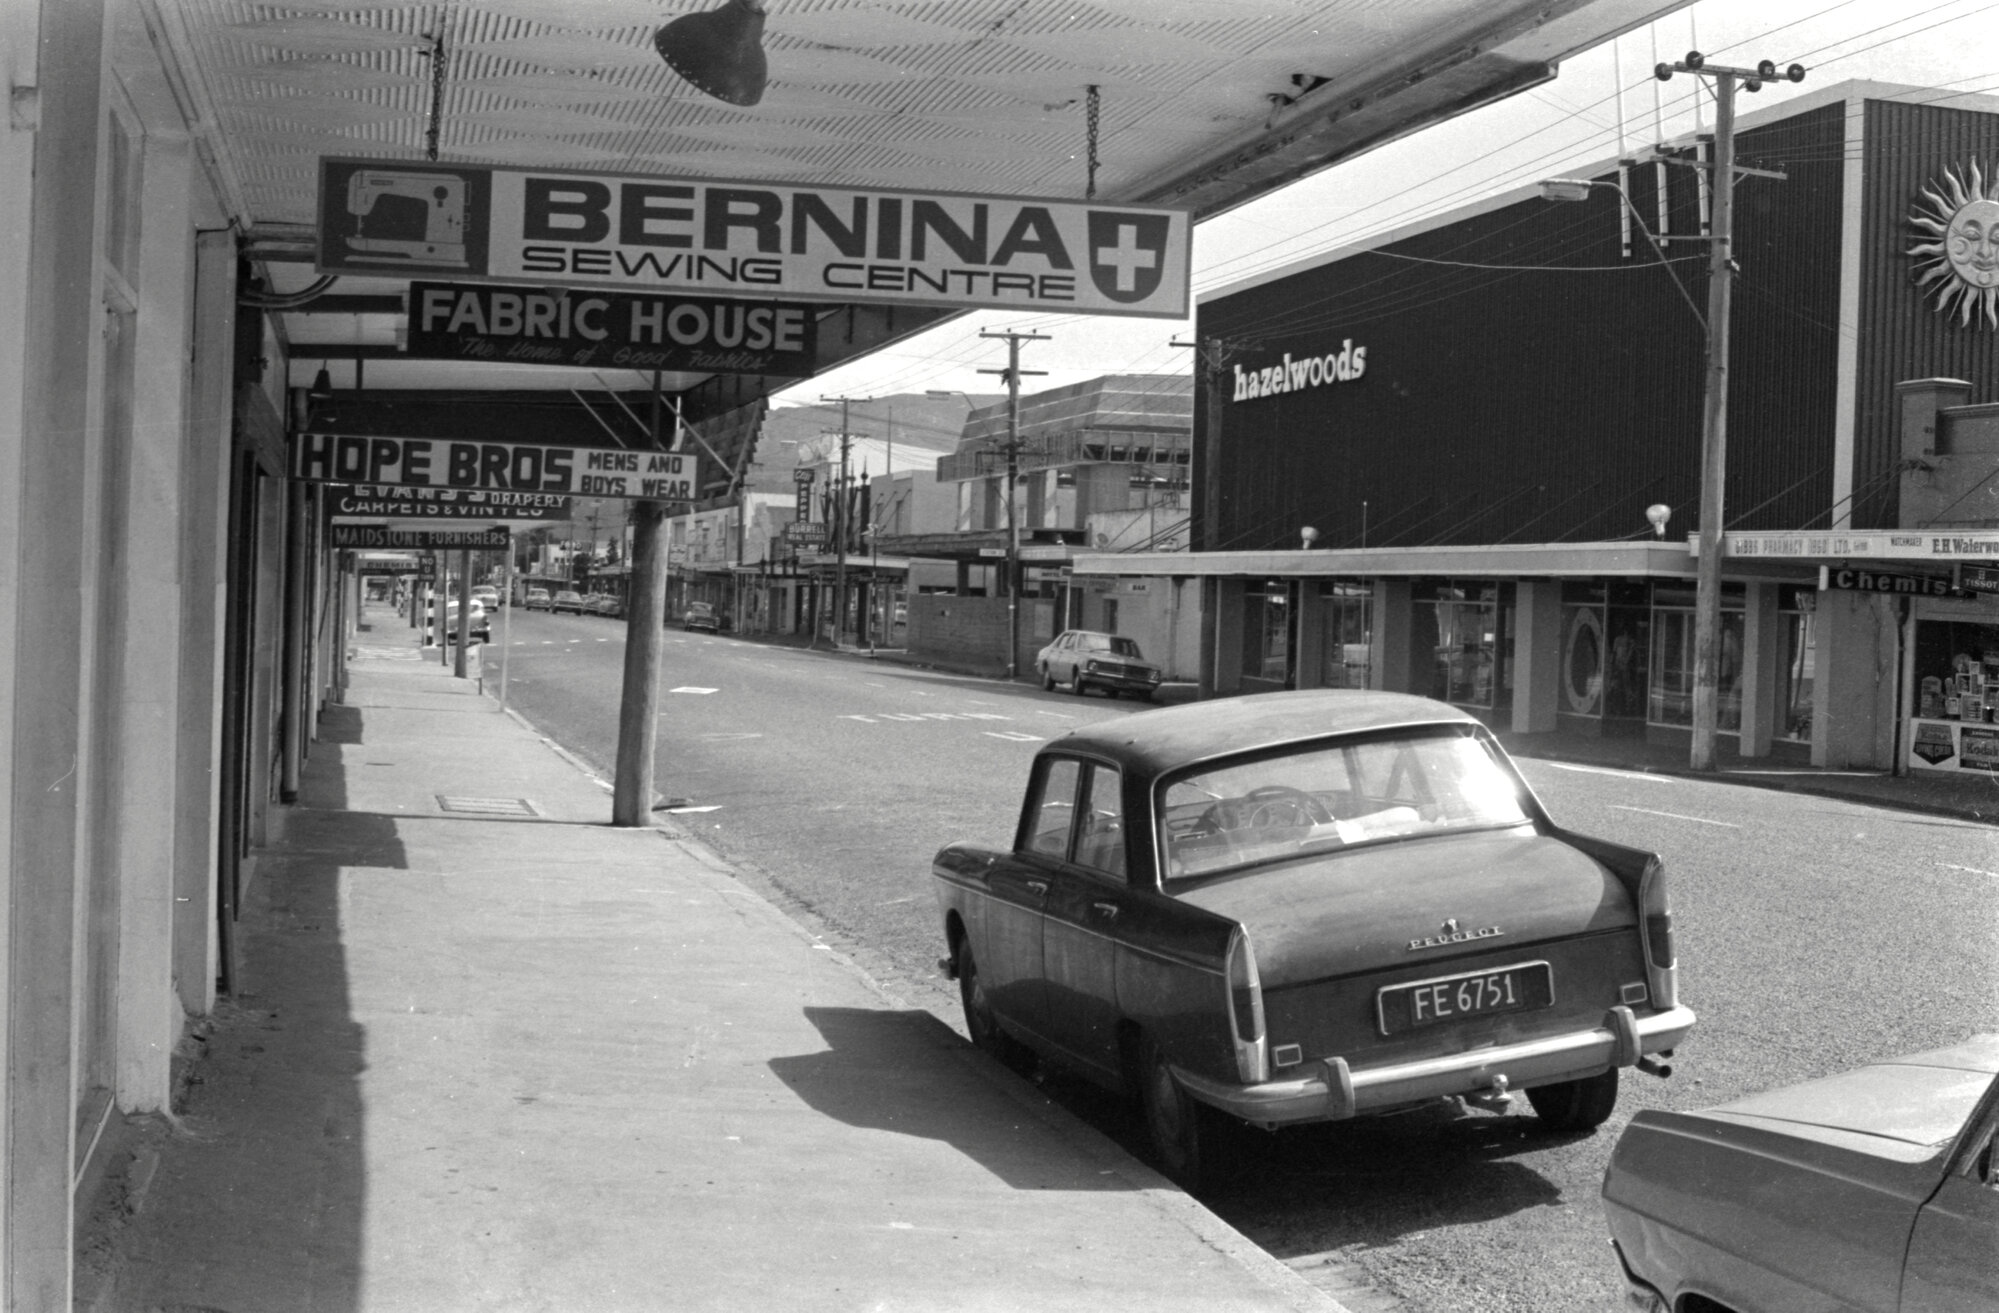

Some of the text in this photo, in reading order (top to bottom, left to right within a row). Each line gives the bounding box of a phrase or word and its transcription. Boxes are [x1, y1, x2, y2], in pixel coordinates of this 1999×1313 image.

[523, 178, 1075, 270] BERNINA
[522, 246, 1076, 301] SEWING CENTRE
[421, 290, 804, 351] FABRIC HOUSE
[507, 341, 562, 361] Home
[574, 345, 599, 364] of
[612, 346, 673, 365] Good
[1233, 338, 1367, 402] hazelwoods
[301, 435, 573, 491] HOPE BROS
[587, 452, 683, 474] MENS AND
[581, 475, 691, 499] BOYS WEAR
[491, 492, 565, 507] DRAPERY
[336, 527, 505, 546] MAIDSTONE FURNISHERS
[1964, 578, 1998, 589] TISSOT
[1409, 926, 1503, 949] PEUGEOT
[1414, 974, 1516, 1020] FE 6751
